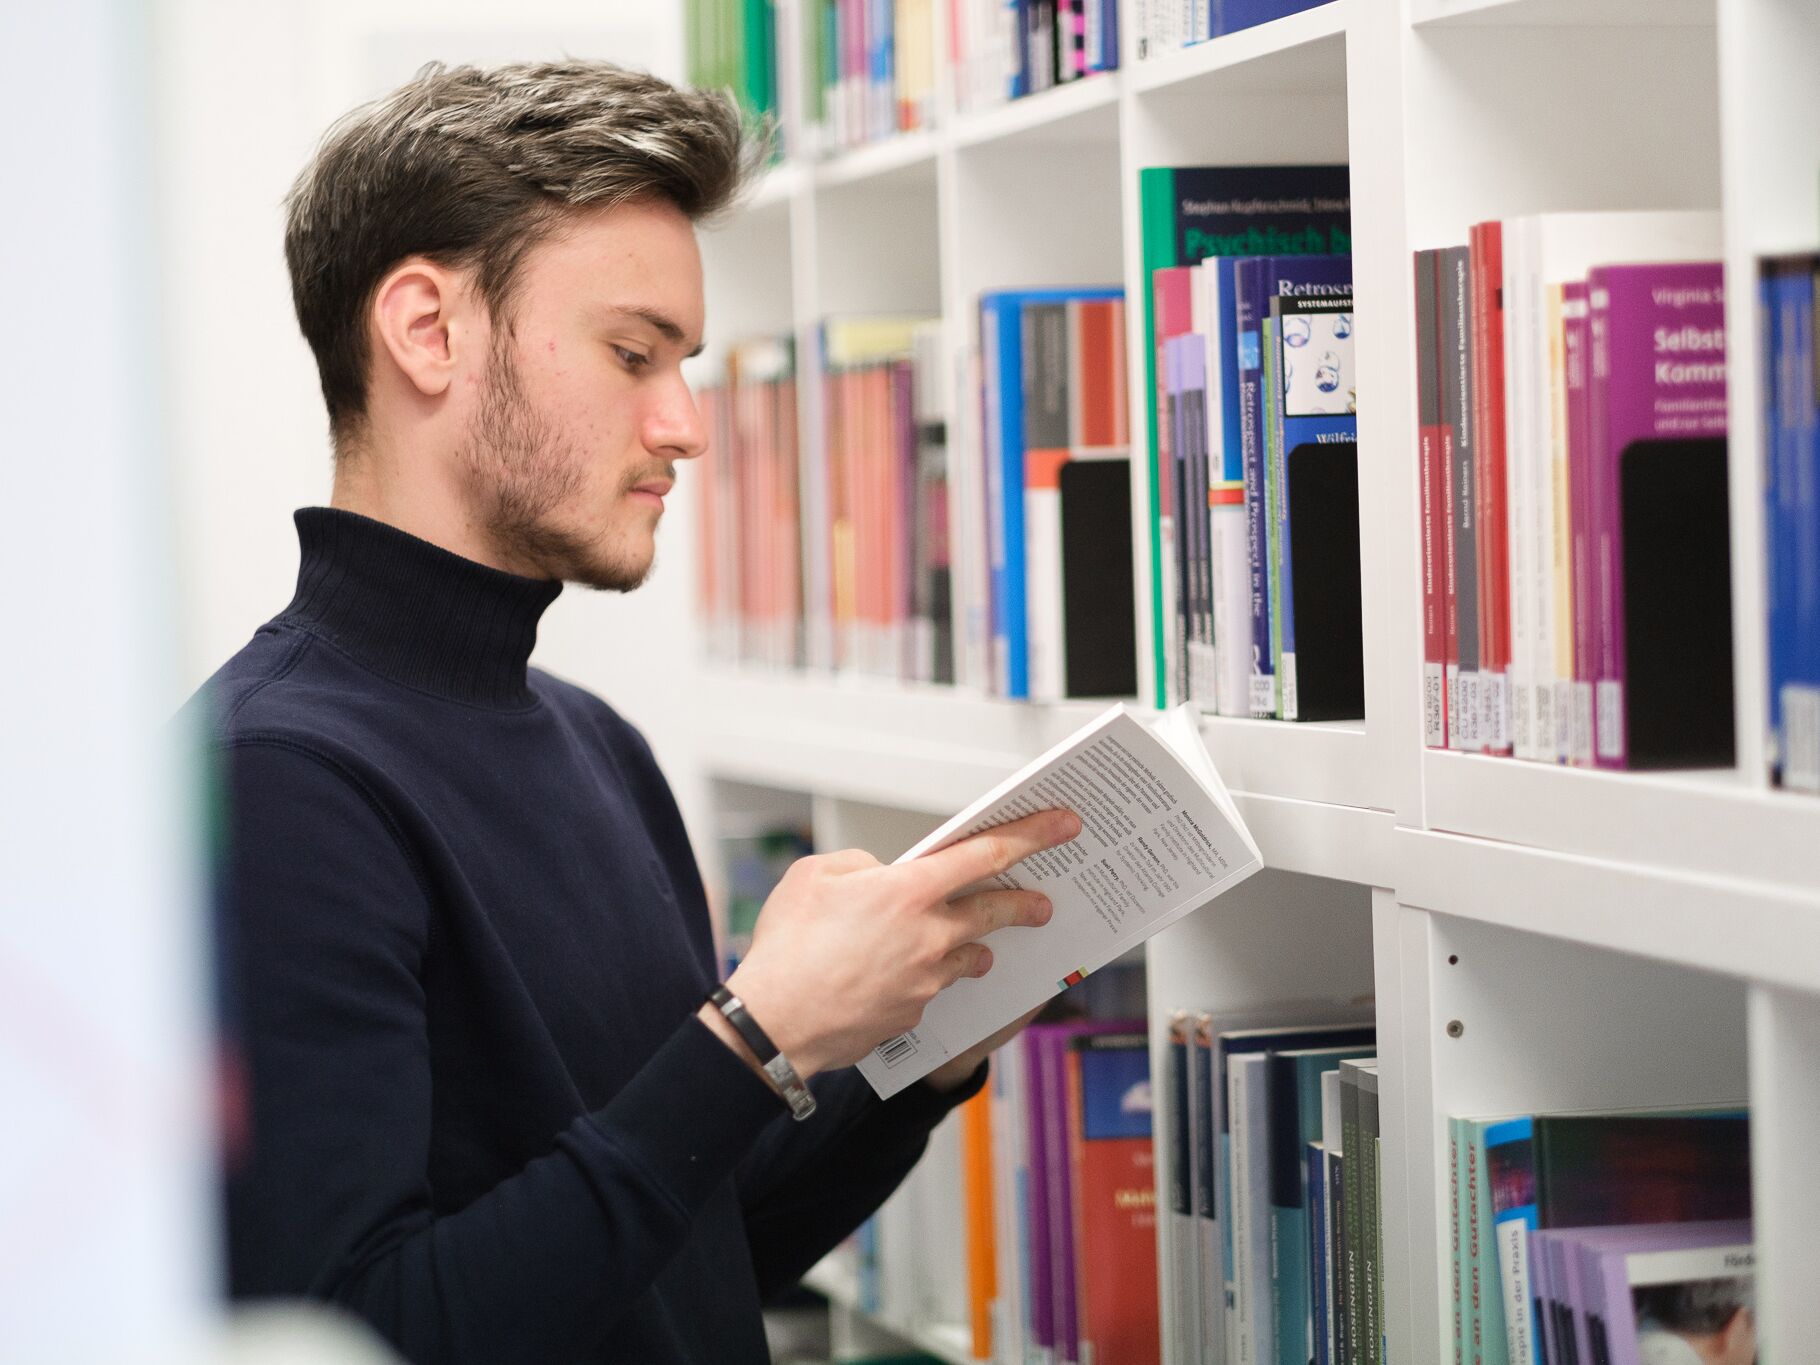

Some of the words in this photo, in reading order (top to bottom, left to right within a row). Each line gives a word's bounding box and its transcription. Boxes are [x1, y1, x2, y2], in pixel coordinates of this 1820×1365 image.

[1185, 224, 1324, 257] Psychisch
[1652, 289, 1710, 308] Virginia
[1654, 327, 1724, 351] Selbst
[1459, 353, 1467, 446] Kinderorientierte
[1244, 381, 1256, 464] Retrospect
[1248, 467, 1259, 496] and
[1422, 436, 1431, 513] Familientherapie
[1249, 501, 1261, 567] Prospect
[1425, 515, 1433, 594] Kinderorientierte
[1251, 572, 1261, 588] in
[1252, 592, 1263, 616] the
[1426, 713, 1431, 734] CU
[1461, 718, 1467, 738] CU
[1181, 810, 1194, 825] Monica
[1192, 824, 1212, 848] McGoldrick,
[1137, 836, 1149, 850] Randy
[1147, 848, 1161, 865] Gerson,
[1448, 1136, 1460, 1251] Gutachter
[1466, 1140, 1478, 1258] Gutachter
[1510, 1229, 1520, 1274] Praxis
[1348, 1249, 1357, 1347] ROSENGREN
[1451, 1259, 1461, 1302] den
[1471, 1266, 1480, 1309] den
[1513, 1279, 1521, 1302] der
[1366, 1259, 1375, 1359] ROSENGREN
[1452, 1311, 1462, 1338] an
[1515, 1307, 1523, 1321] in
[1472, 1317, 1481, 1345] an
